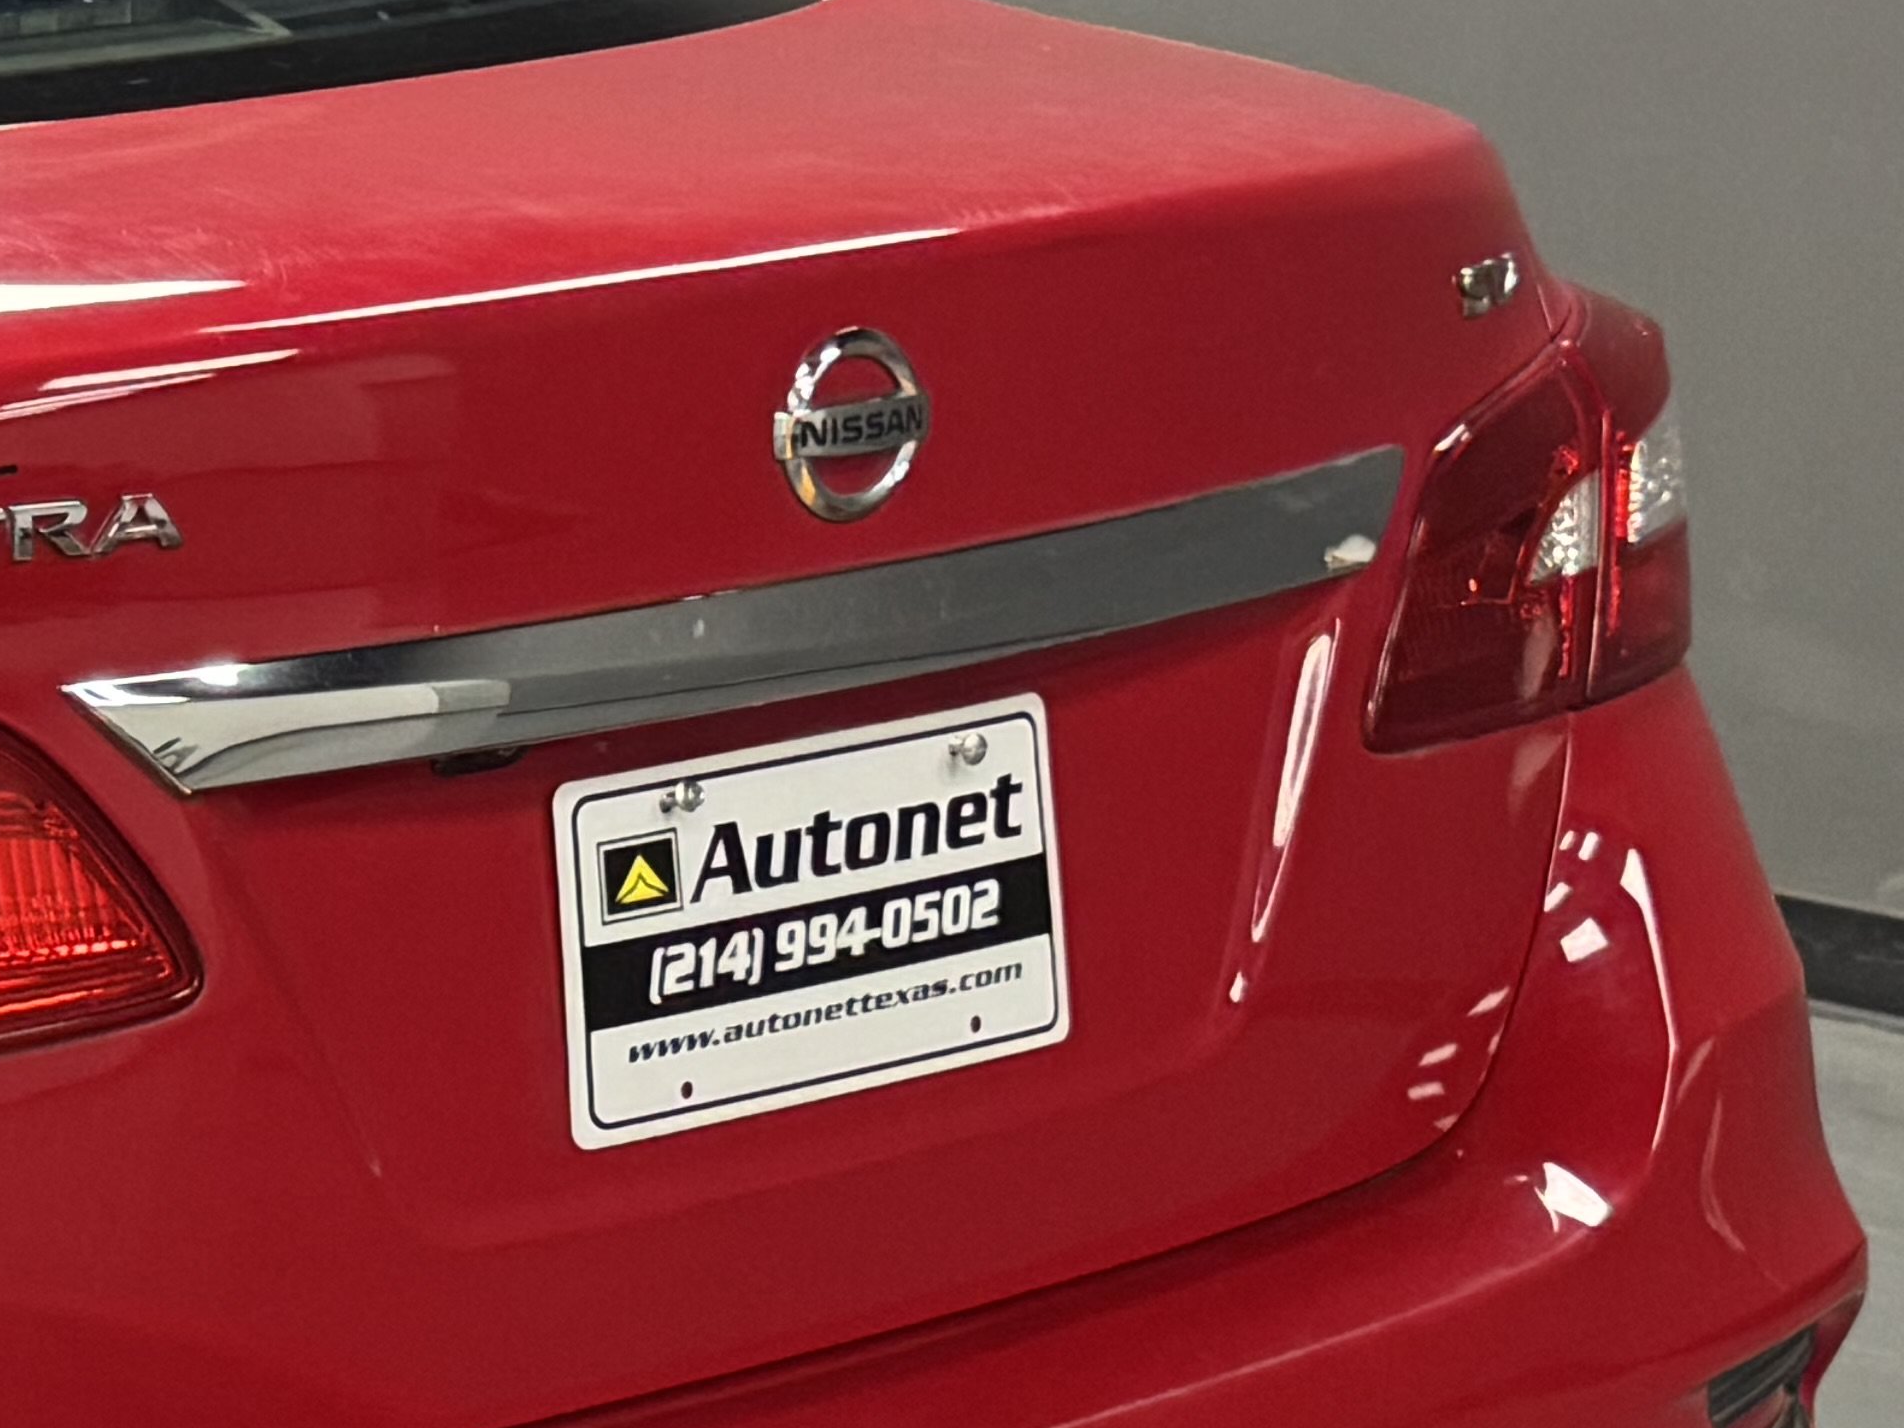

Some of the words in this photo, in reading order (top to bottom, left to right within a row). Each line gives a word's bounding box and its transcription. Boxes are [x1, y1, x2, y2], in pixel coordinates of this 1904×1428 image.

[800, 404, 923, 448] NISSAN
[690, 773, 1023, 904] Autonet
[649, 928, 765, 1005] (214)
[774, 878, 1000, 972] 994-0502
[628, 961, 1023, 1063] www.autonettexas.com
